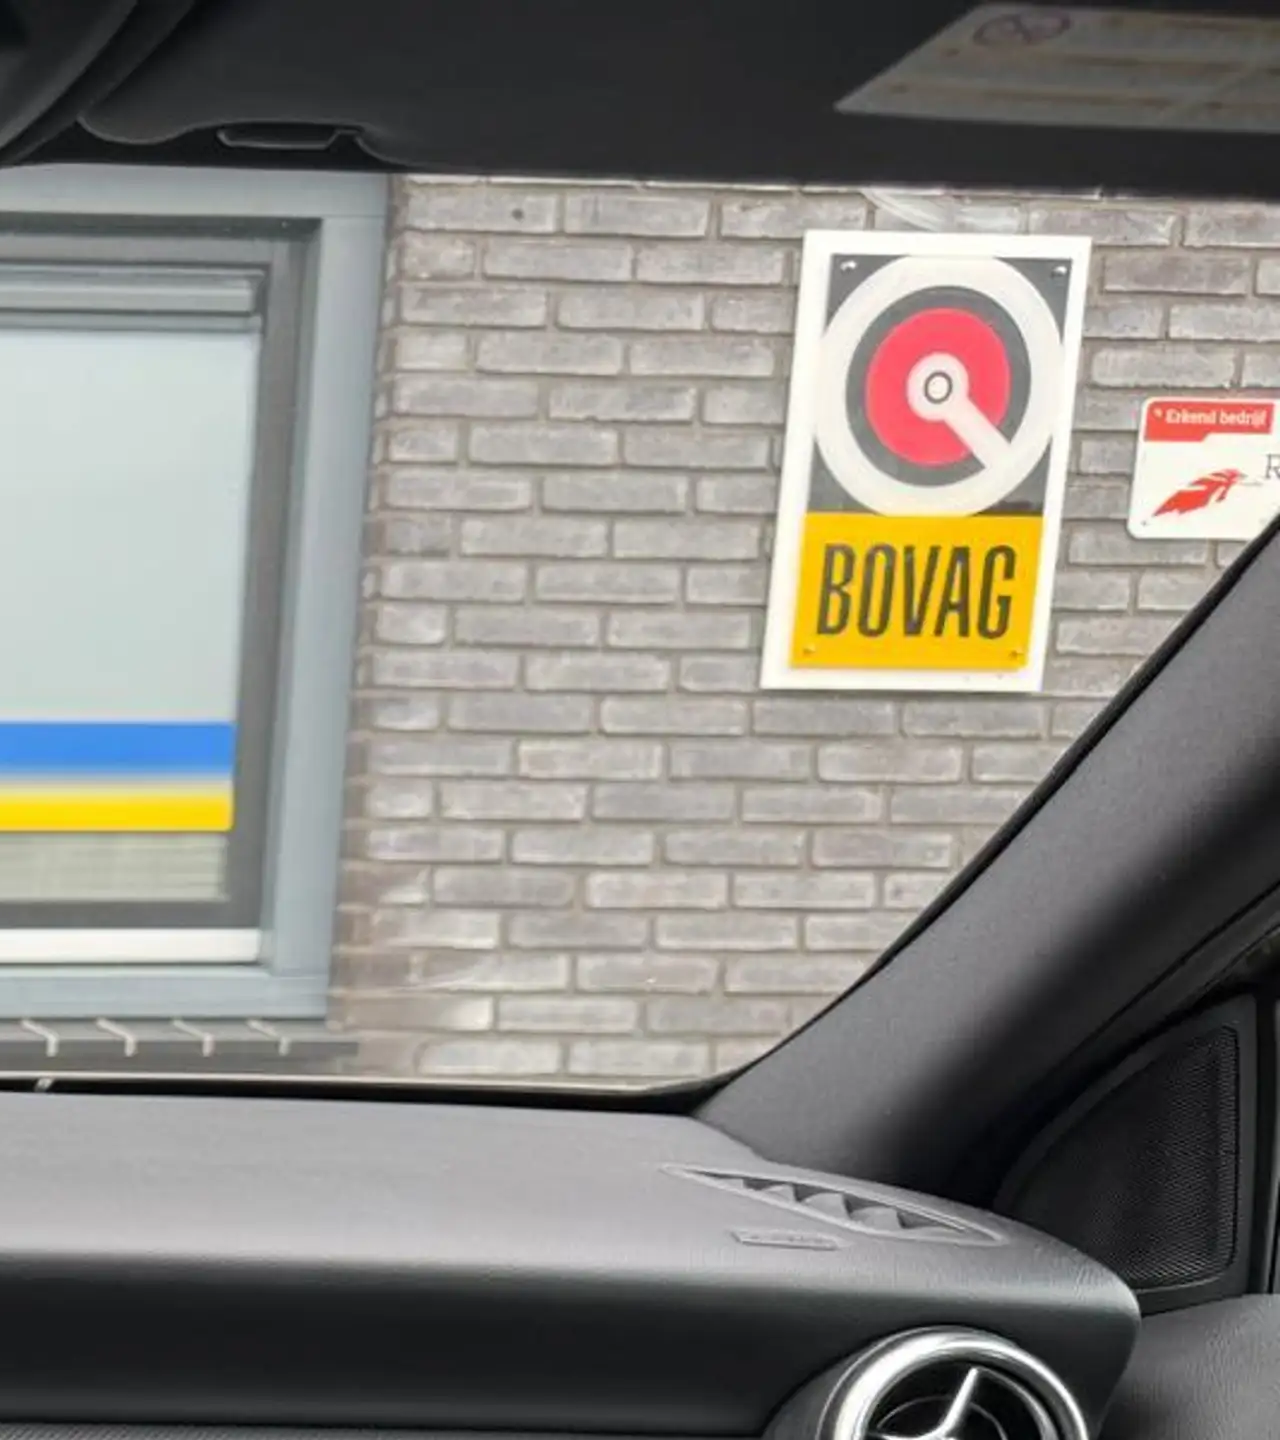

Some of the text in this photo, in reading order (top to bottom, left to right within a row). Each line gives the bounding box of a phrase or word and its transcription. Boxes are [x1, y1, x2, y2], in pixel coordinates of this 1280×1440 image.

[1166, 408, 1269, 429] Erkend bedrijf
[817, 543, 1017, 639] BOVAG
